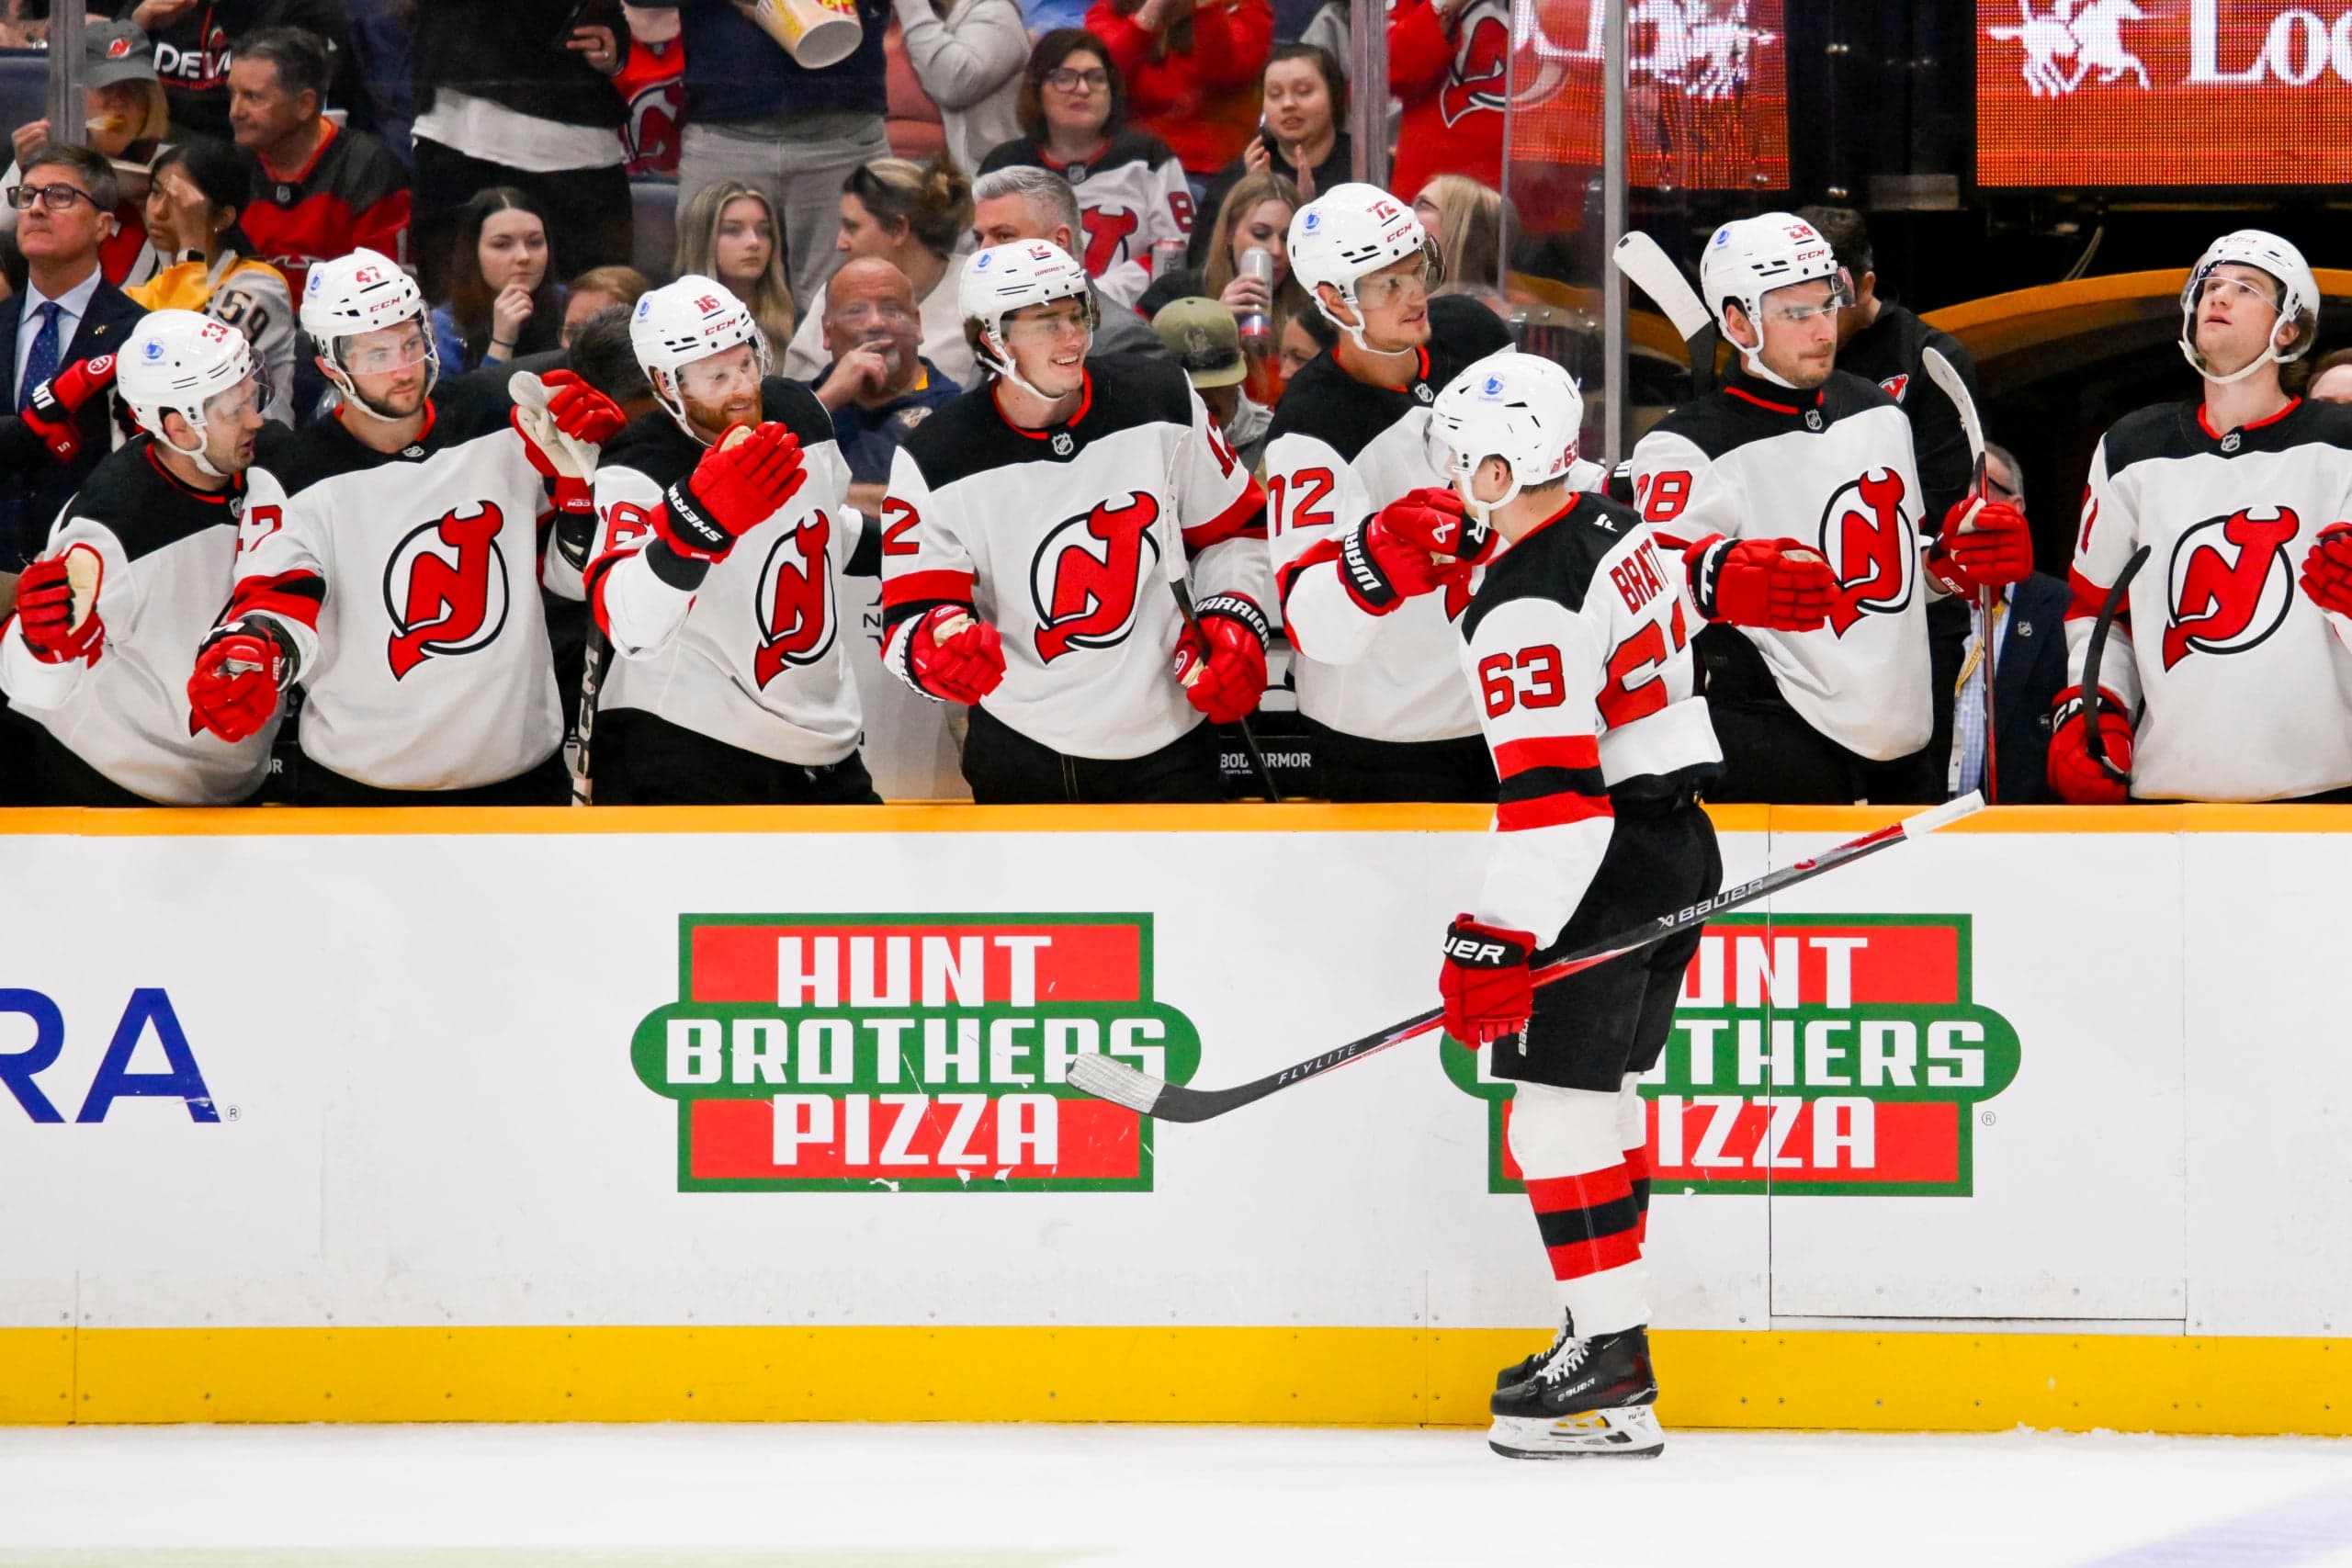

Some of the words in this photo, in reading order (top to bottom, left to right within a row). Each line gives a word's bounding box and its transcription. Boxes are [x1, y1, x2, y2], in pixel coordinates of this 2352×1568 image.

[2190, 0, 2352, 85] Lo
[1386, 223, 1412, 243] CCM
[1797, 249, 1825, 261] CCM
[368, 297, 401, 313] CCM
[705, 319, 736, 336] CCM
[1478, 644, 1566, 720] 63
[1679, 878, 1764, 923] BAUER
[777, 936, 1052, 1008] HUNT
[1278, 1043, 1358, 1085] FLYLITE
[773, 1093, 1058, 1166] PIZZA
